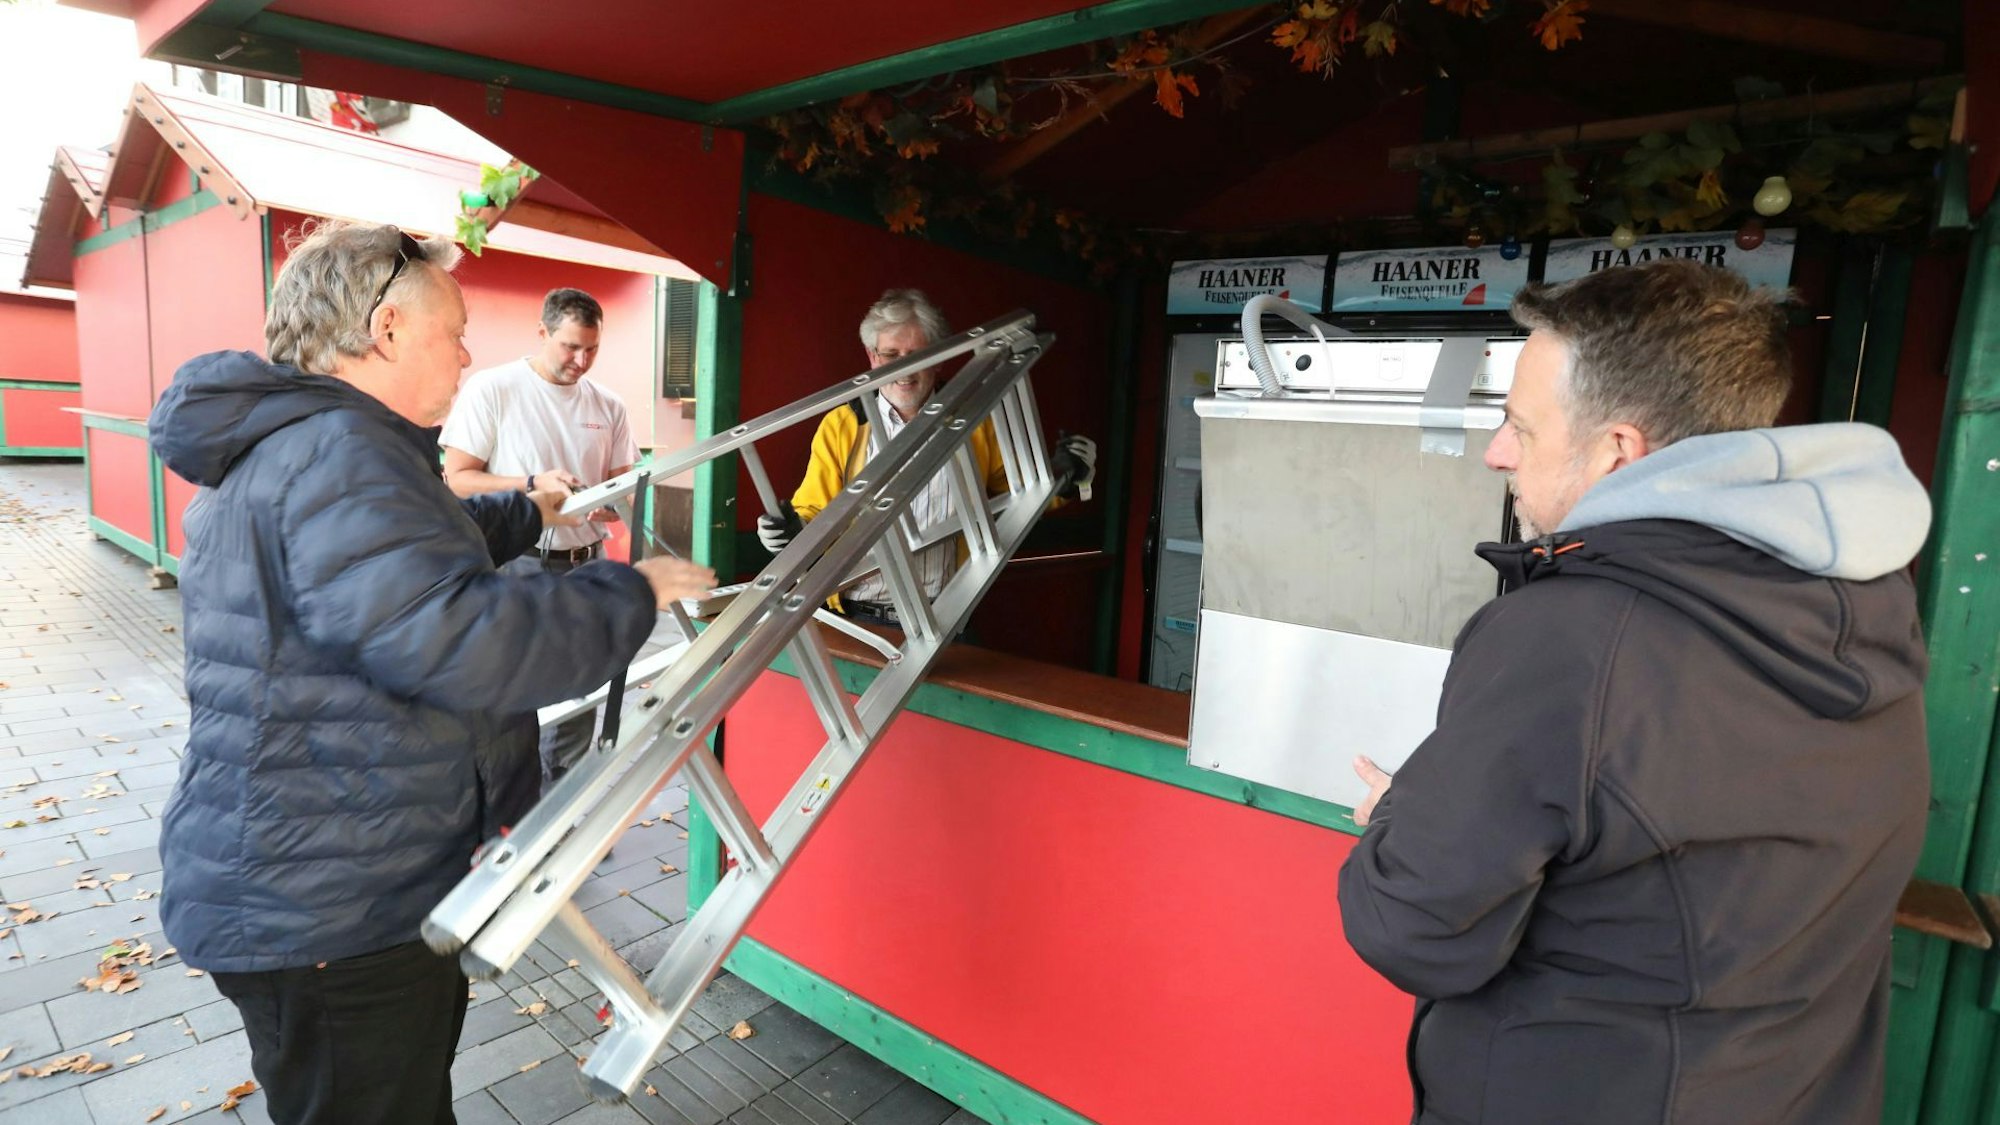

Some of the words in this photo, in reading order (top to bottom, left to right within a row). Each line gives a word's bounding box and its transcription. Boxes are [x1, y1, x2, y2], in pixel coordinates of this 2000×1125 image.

[1371, 257, 1481, 282] HAANER
[1589, 245, 1727, 273] HAANER
[1198, 267, 1286, 288] HAANER
